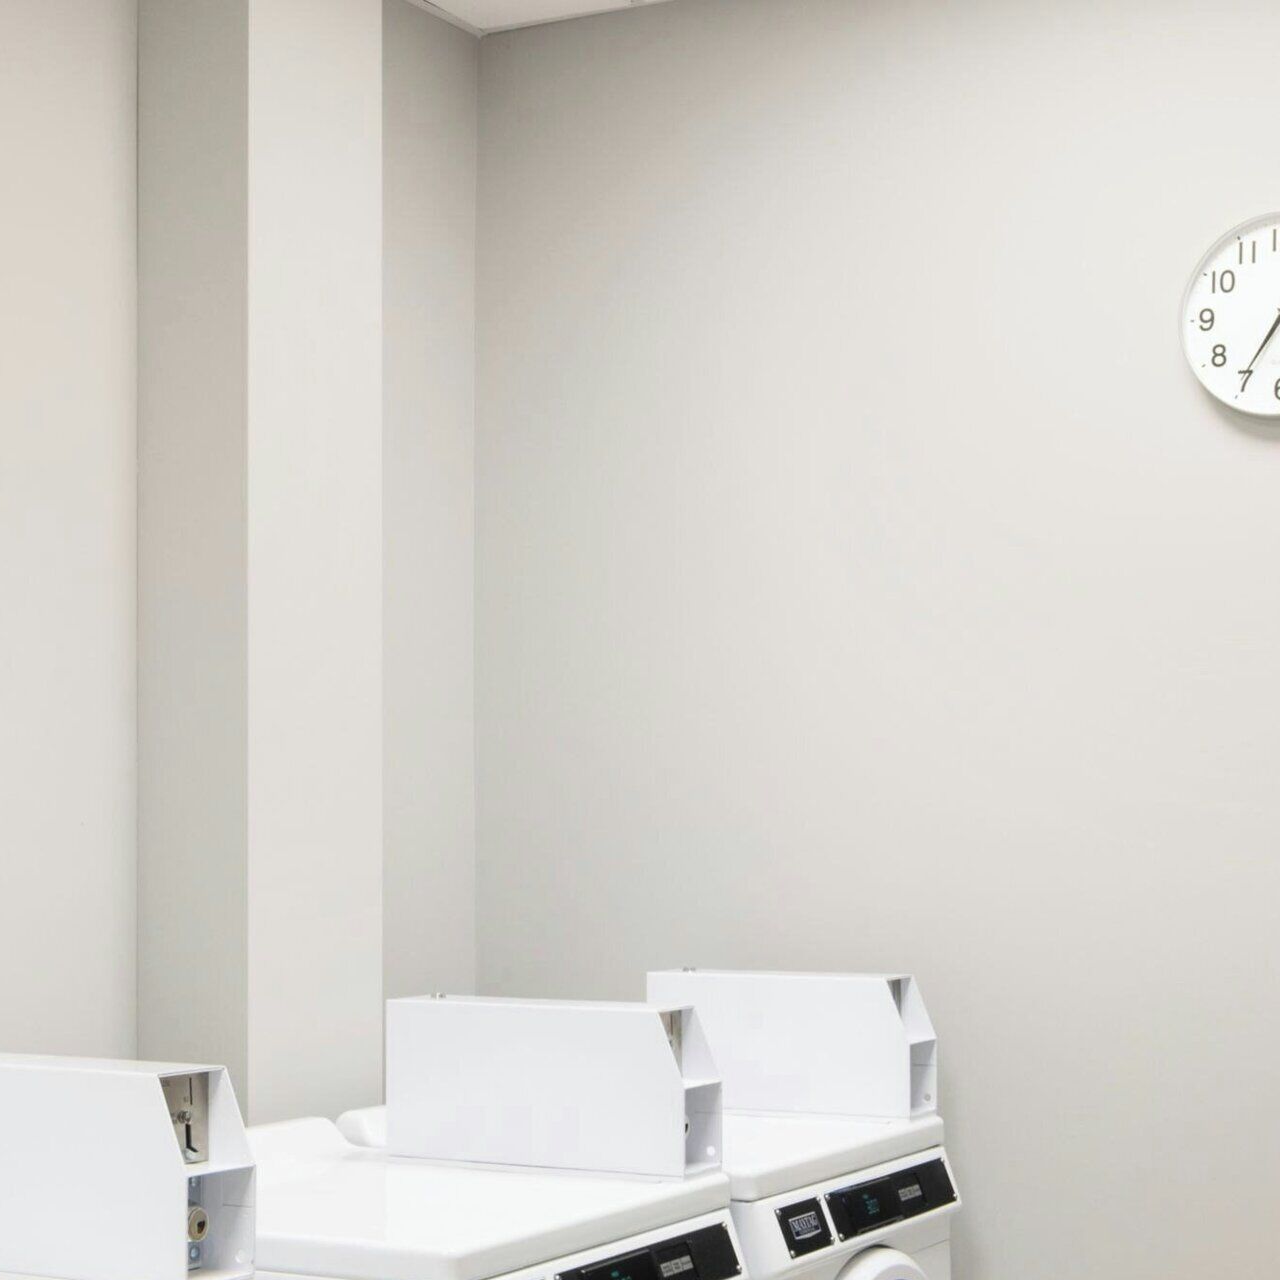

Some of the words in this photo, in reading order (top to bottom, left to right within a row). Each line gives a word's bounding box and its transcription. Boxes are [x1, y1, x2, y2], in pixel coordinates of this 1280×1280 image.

[1238, 240, 1256, 264] 11
[1211, 269, 1236, 294] 10
[1198, 308, 1215, 331] 9
[1210, 344, 1227, 367] 8
[1237, 369, 1254, 393] 7
